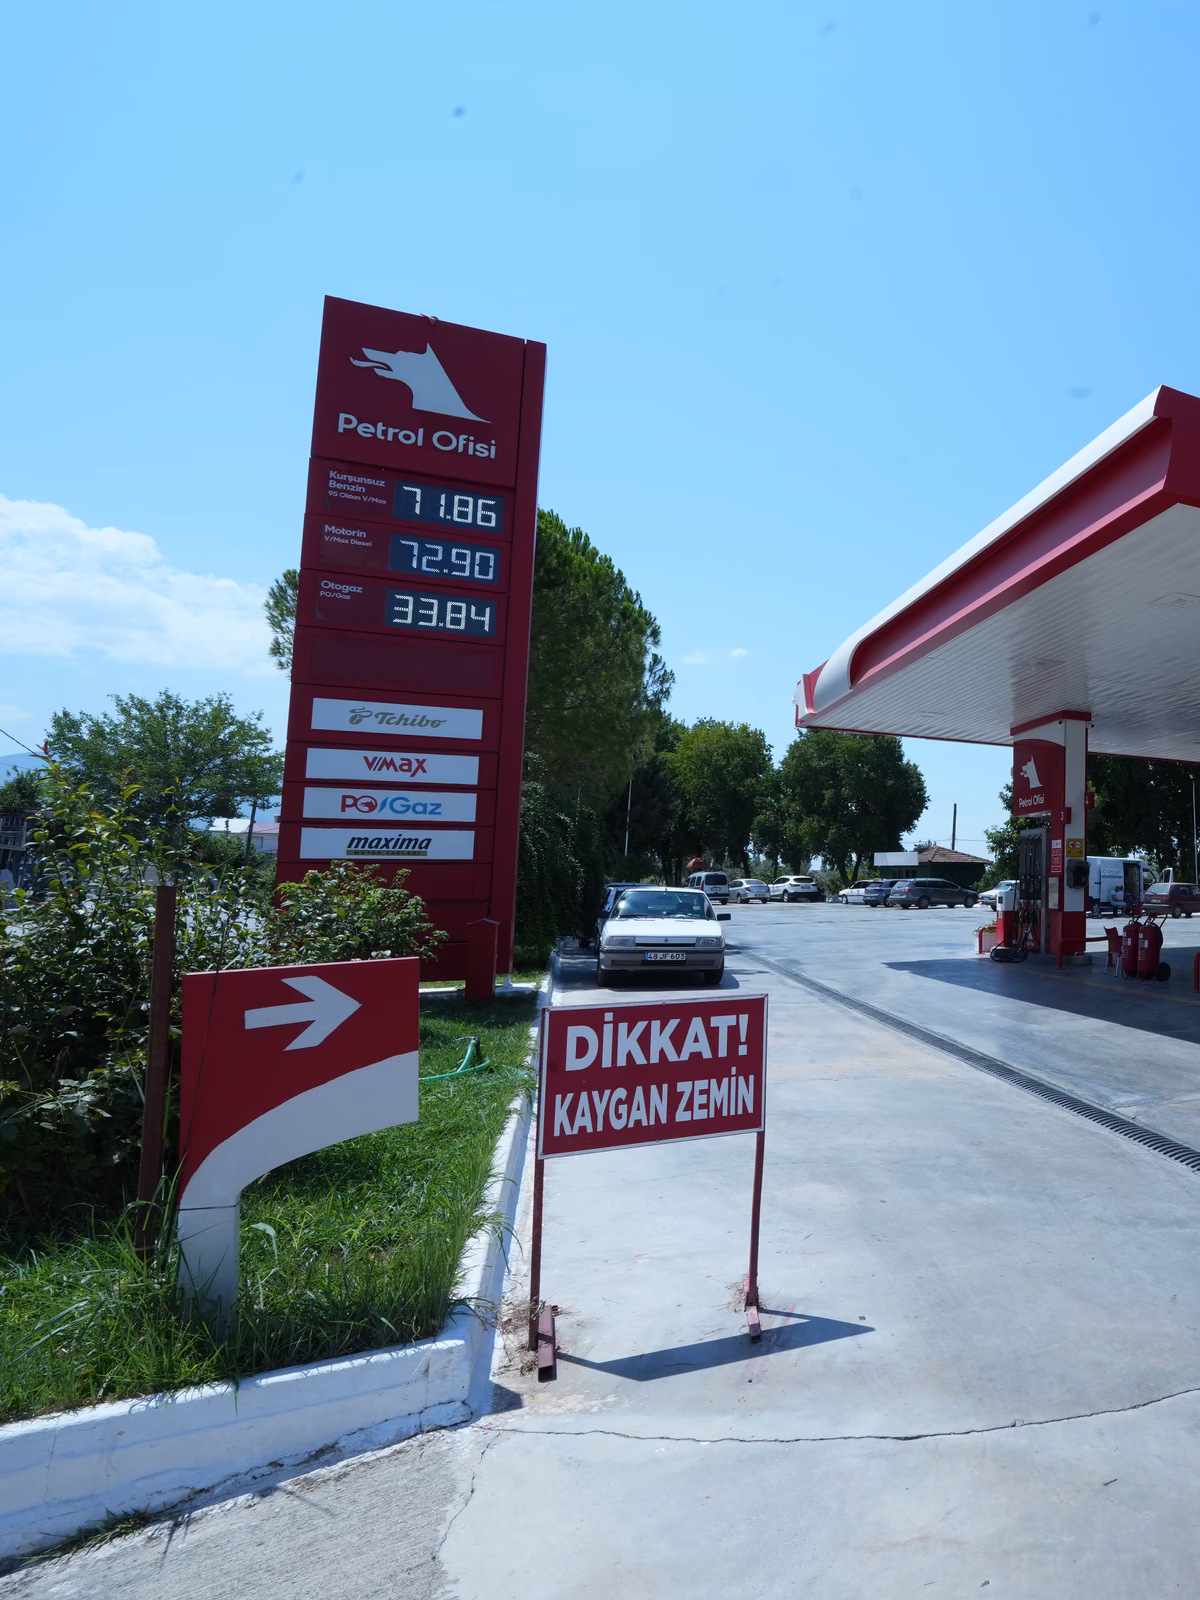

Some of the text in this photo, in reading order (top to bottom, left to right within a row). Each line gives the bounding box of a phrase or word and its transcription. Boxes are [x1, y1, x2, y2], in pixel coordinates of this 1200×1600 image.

[338, 412, 496, 459] Petrol Ofisi
[328, 479, 366, 493] Benzin
[329, 470, 385, 487] Kurşunsuz
[339, 492, 361, 501] Oktan
[362, 495, 387, 505] V/Max
[402, 485, 496, 528] 71.86
[324, 524, 367, 538] Motorin
[324, 535, 372, 547] V/Max Diesel
[399, 539, 495, 581] 72.90
[320, 590, 351, 600] PO/Gaz
[321, 580, 363, 594] Otogaz
[392, 594, 491, 632] 33.84
[374, 711, 448, 728] Tchibo
[1018, 793, 1045, 808] Petrol Ofisi
[1060, 811, 1064, 821] 3
[346, 834, 433, 850] maxima
[565, 1011, 749, 1072] DİKKAT!
[553, 1066, 755, 1137] KAYGAN ZEMİN
